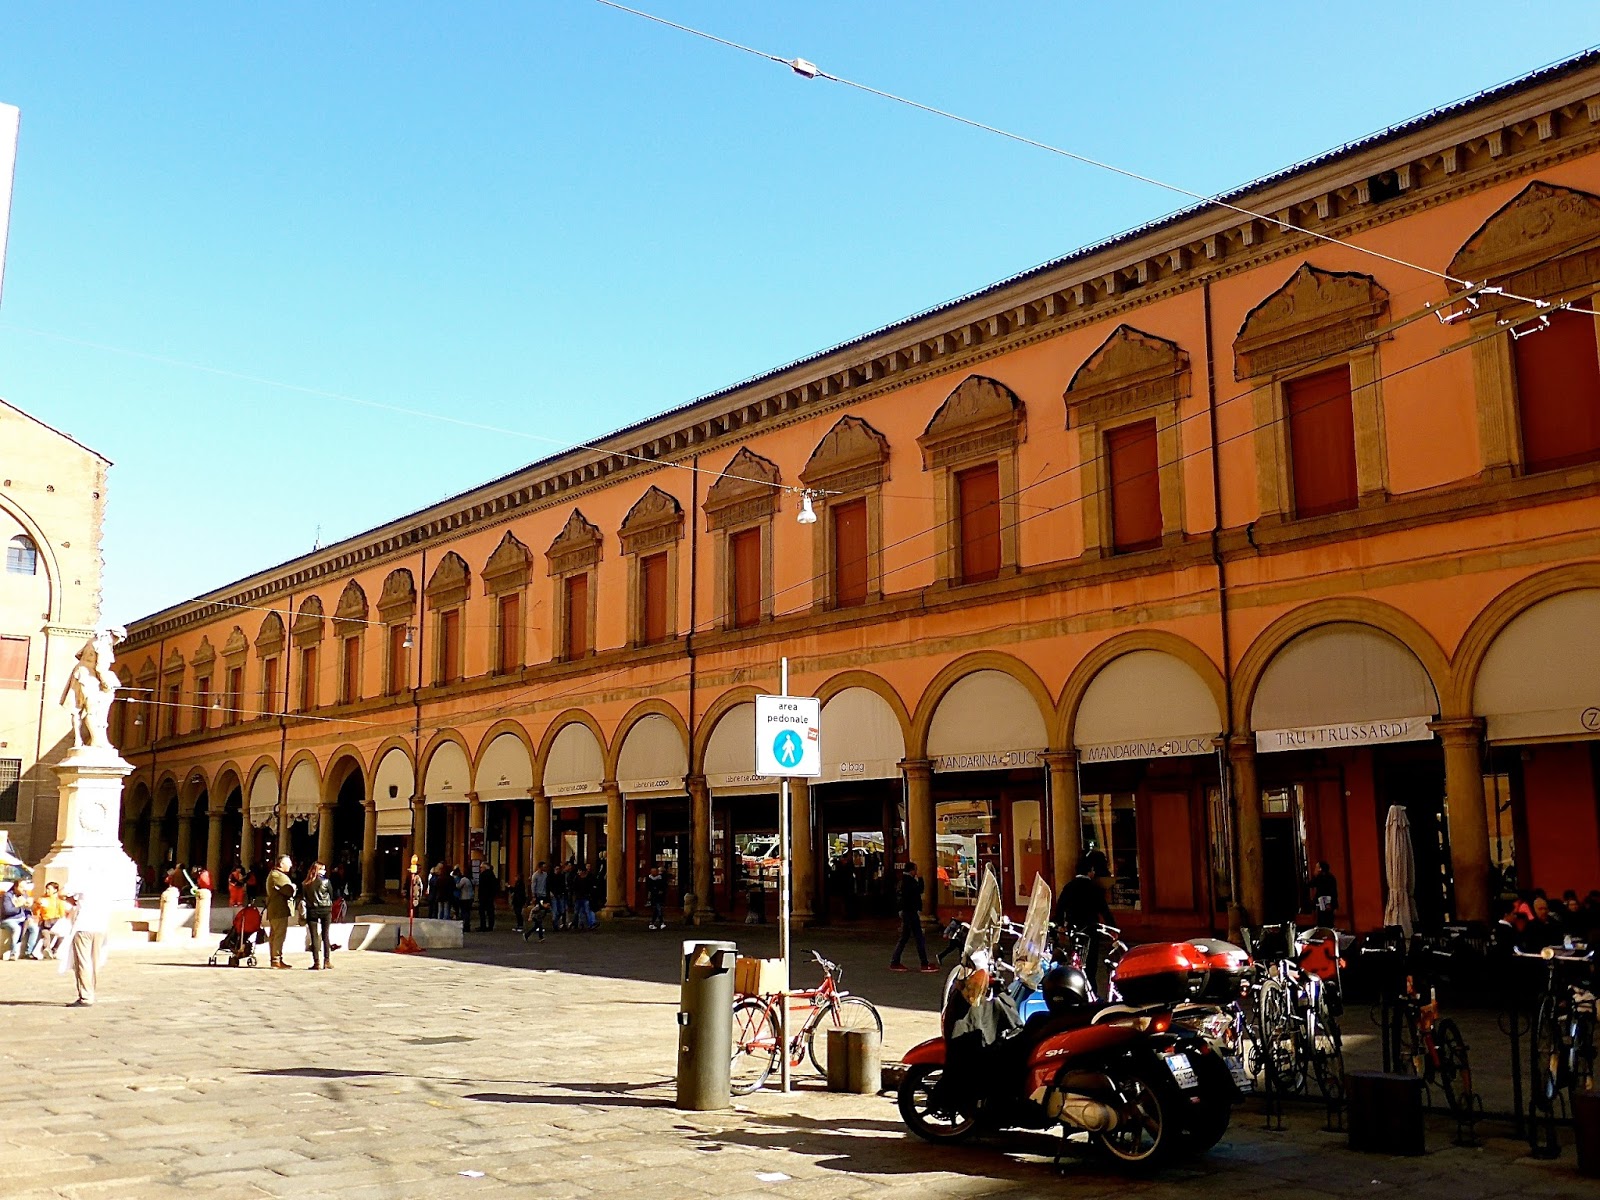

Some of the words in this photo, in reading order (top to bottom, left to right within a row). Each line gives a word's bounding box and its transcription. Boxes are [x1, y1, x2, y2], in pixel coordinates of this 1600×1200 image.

[778, 703, 798, 711] area
[767, 714, 809, 724] pedonale
[1275, 730, 1306, 746] TRU
[1316, 722, 1409, 743] TRUSSARDI
[1088, 742, 1157, 761] MANDARINA
[1171, 738, 1206, 754] DUCK
[936, 754, 998, 769] MANDARINA
[1011, 751, 1042, 765] DUCK
